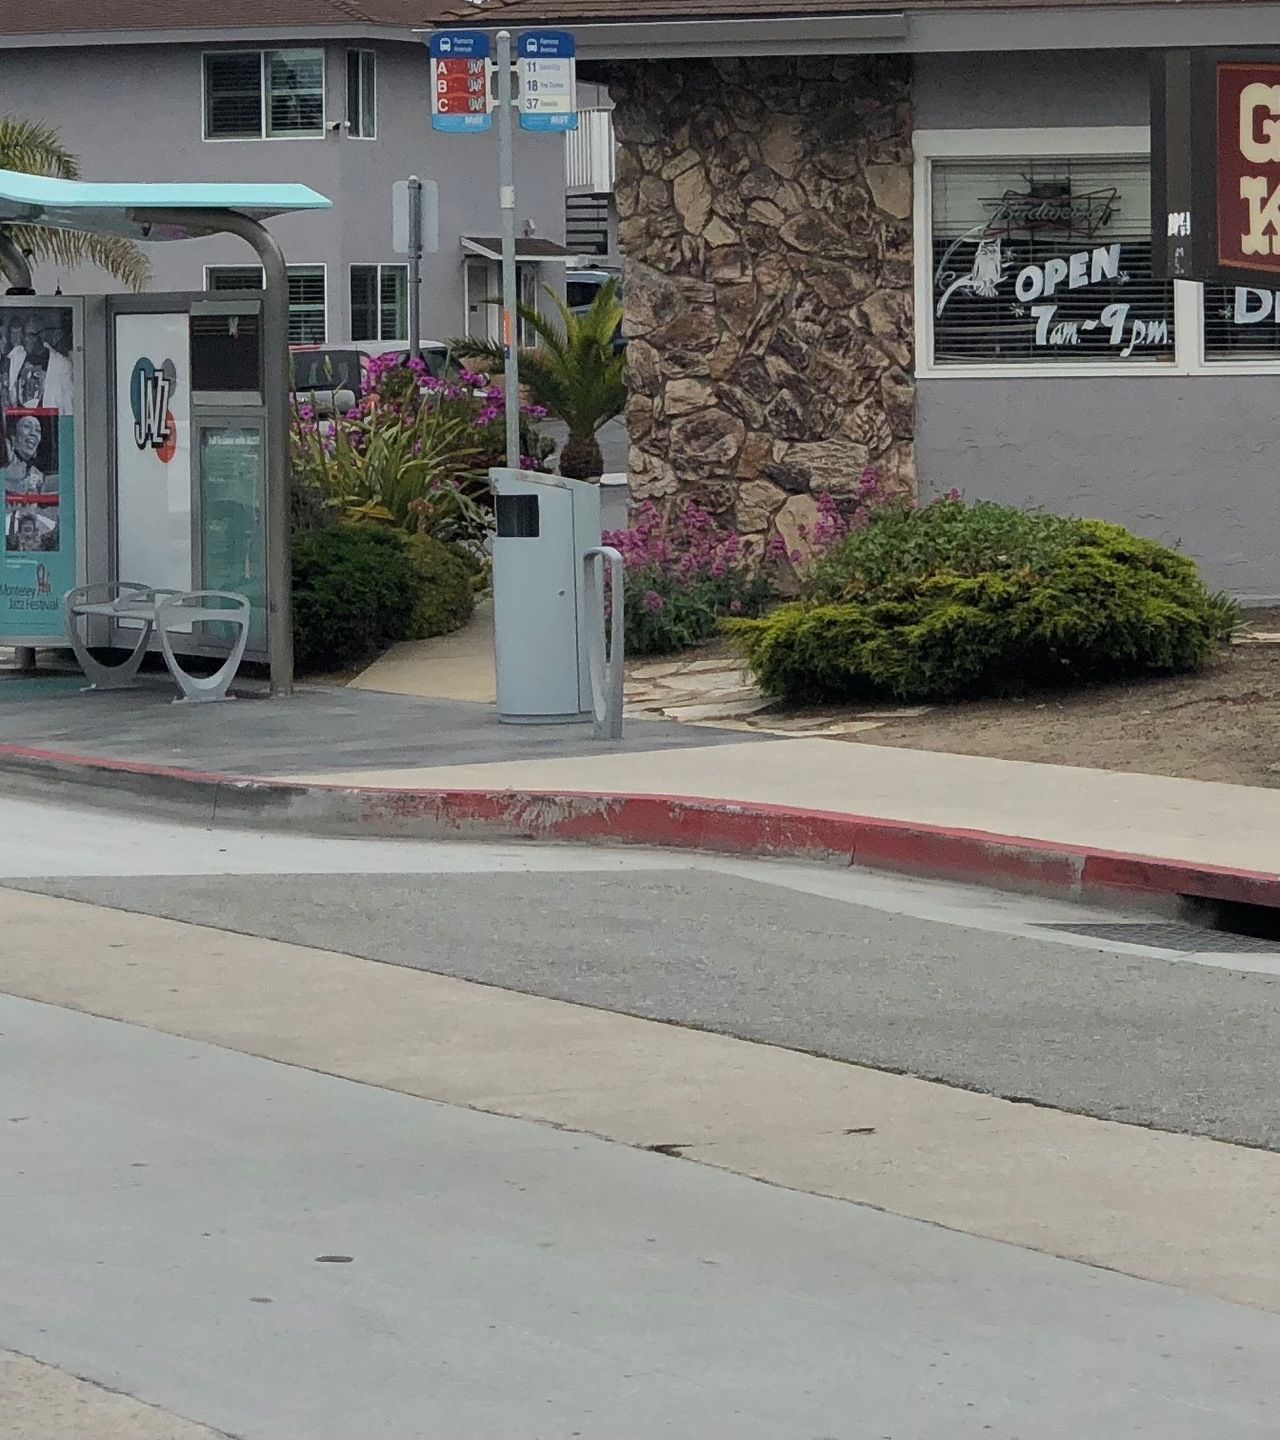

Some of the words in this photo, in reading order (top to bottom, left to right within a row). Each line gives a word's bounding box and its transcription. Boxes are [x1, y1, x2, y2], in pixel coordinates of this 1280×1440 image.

[437, 61, 447, 75] A
[526, 62, 537, 72] 11
[438, 80, 448, 93] B
[526, 80, 538, 92] 18
[438, 99, 448, 112] C
[526, 98, 539, 110] 37
[1015, 244, 1121, 302] OPEN
[133, 368, 171, 450] JAZZ
